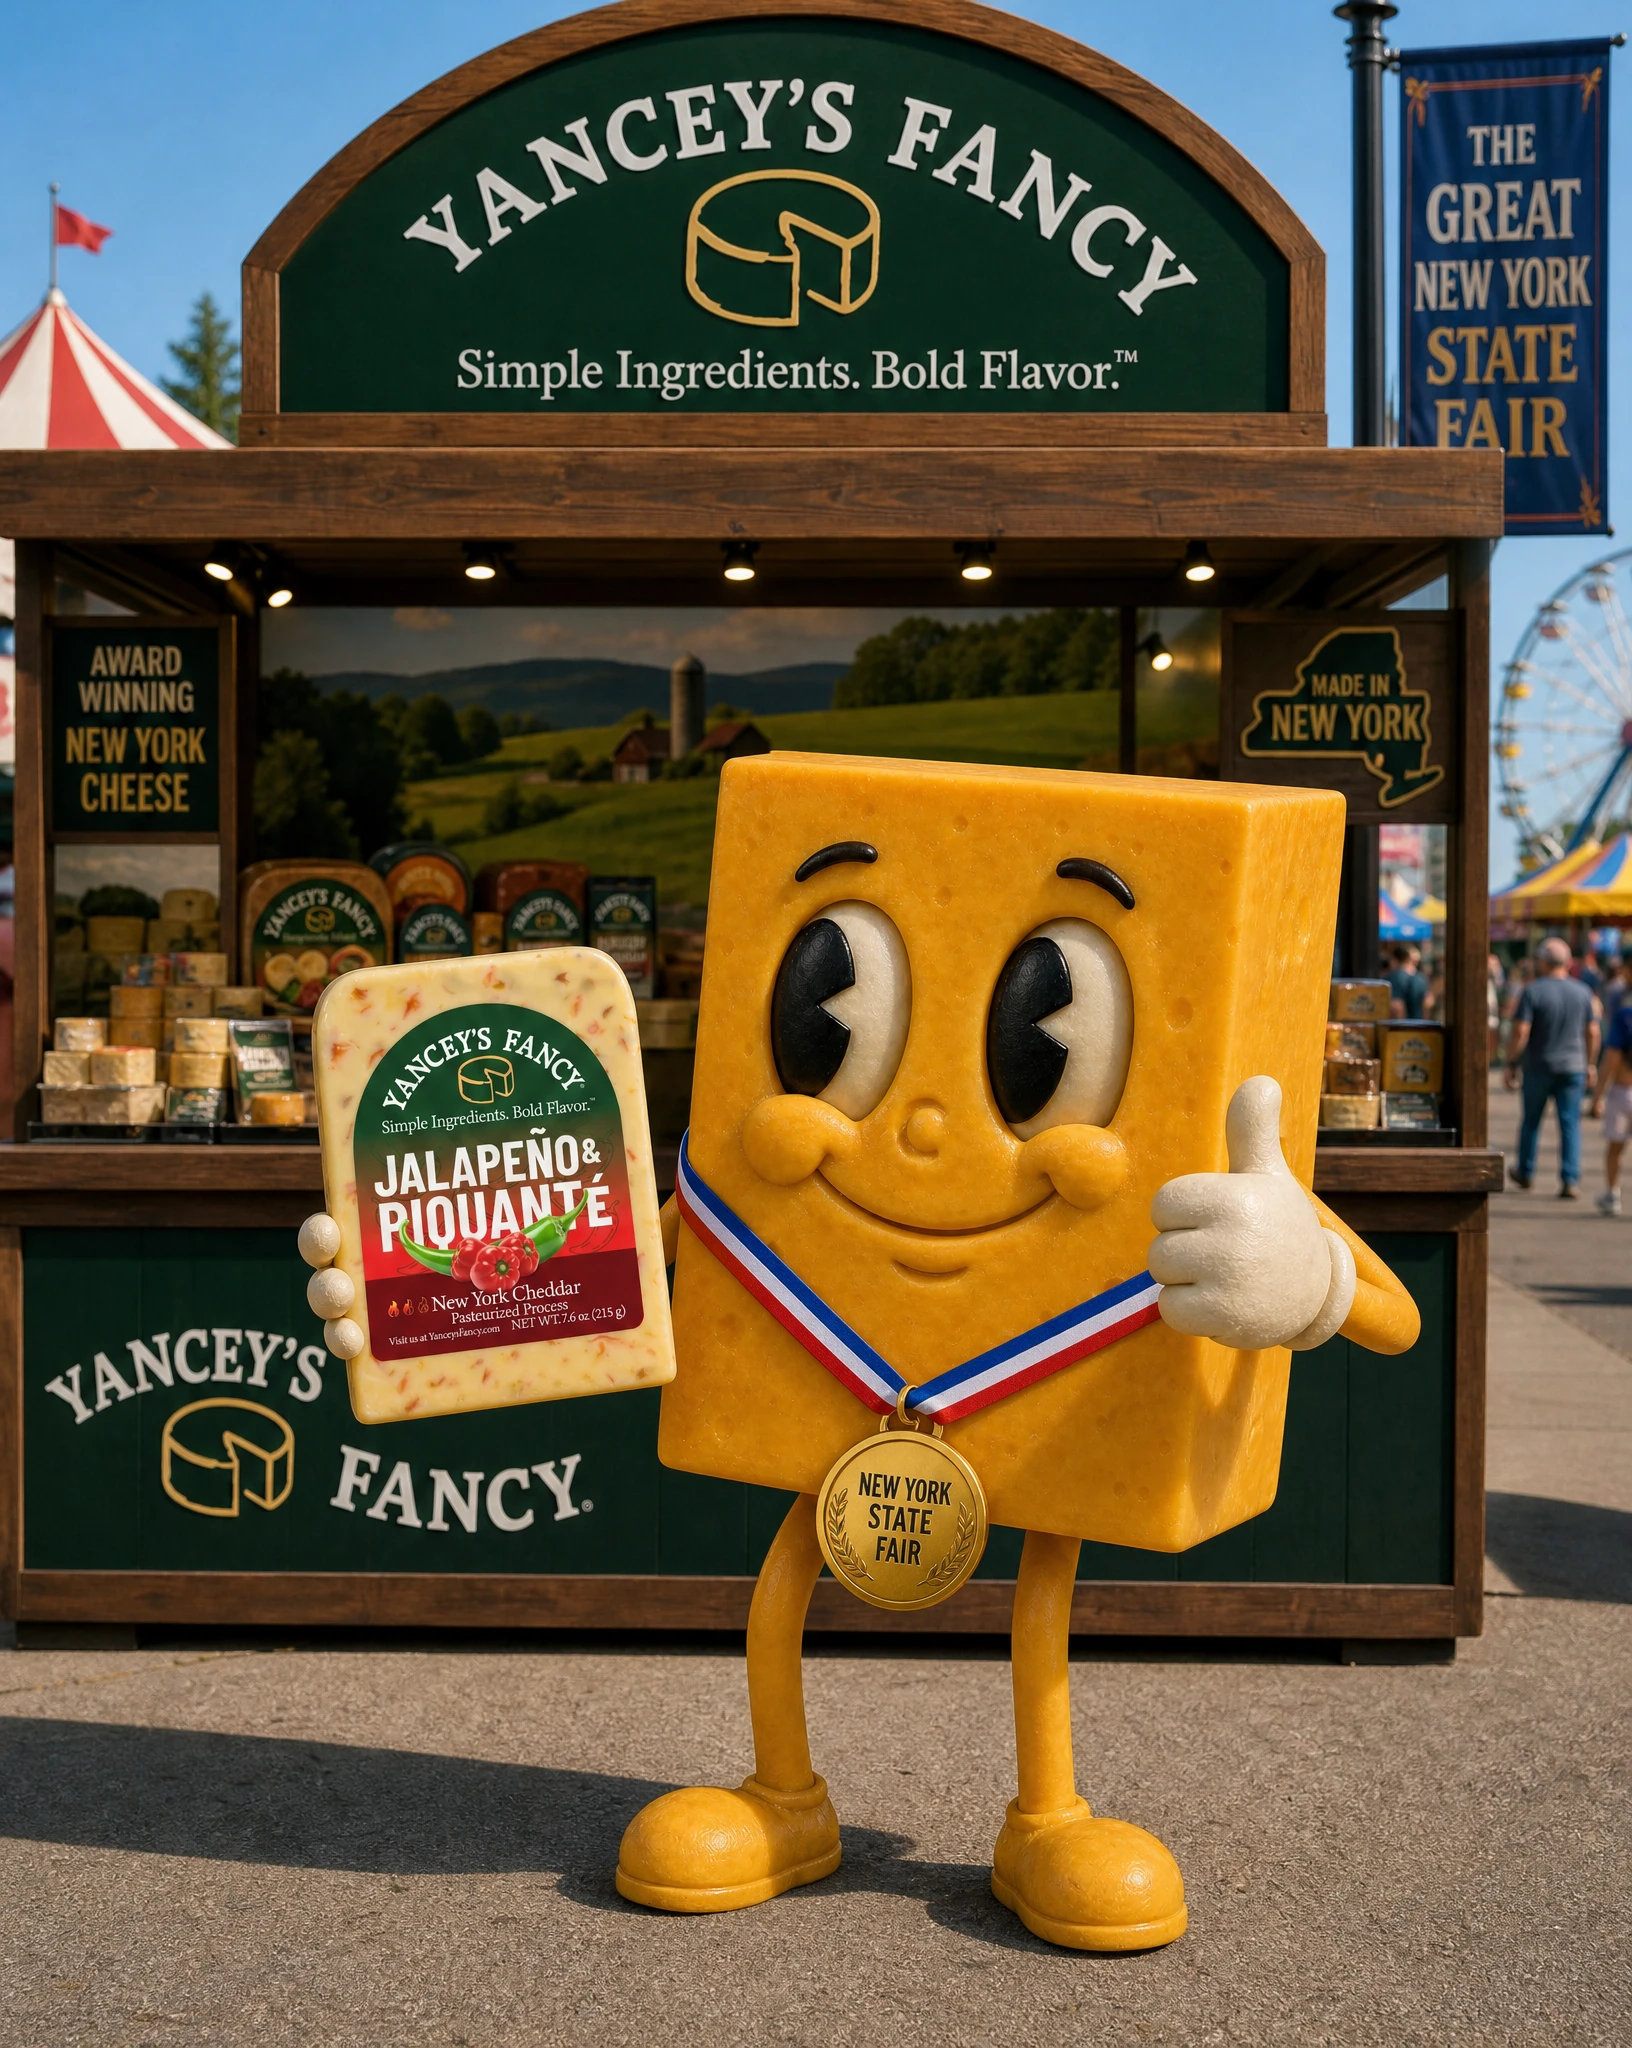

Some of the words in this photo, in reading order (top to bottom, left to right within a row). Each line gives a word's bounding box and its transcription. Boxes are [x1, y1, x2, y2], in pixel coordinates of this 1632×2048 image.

[1467, 123, 1536, 167] THE
[403, 78, 855, 273] YANCEY'S
[887, 96, 1198, 316] FANCY
[1425, 177, 1582, 244] GREAT
[1414, 259, 1494, 312] NEW
[1500, 255, 1593, 309] YORK
[1426, 323, 1579, 386] STATE
[457, 348, 603, 400] Simple
[616, 348, 860, 401] Ingredients.
[872, 348, 967, 390] Bold
[1435, 397, 1571, 459] FAIR
[90, 646, 182, 677] AWARD
[78, 681, 194, 713] WINNING
[1311, 674, 1365, 697] MADE
[1370, 674, 1390, 697] IN
[1271, 704, 1338, 741] NEW
[1345, 704, 1422, 741] YORK
[65, 727, 128, 764] NEW
[134, 727, 207, 764] YORK
[81, 772, 190, 812] CHEESE
[331, 890, 377, 938] FANCY
[382, 1027, 491, 1110] YANCEY'S
[382, 1116, 428, 1135] Simple
[431, 1109, 509, 1131] Ingredients.
[512, 1102, 543, 1119] Bold
[379, 1173, 613, 1253] PIQUANTÉ
[431, 1295, 469, 1312] New
[471, 1288, 510, 1307] York
[512, 1280, 581, 1301] Cheddar
[451, 1304, 519, 1324] Pasteurized
[523, 1301, 568, 1315] Process
[511, 1317, 536, 1330] NET
[578, 1313, 590, 1321] oz
[591, 1307, 614, 1322] (215
[389, 1335, 407, 1346] Visit
[419, 1334, 428, 1342] at
[44, 1328, 327, 1425] YANCEY'S
[858, 1472, 901, 1499] NEW
[904, 1477, 952, 1506] YORK
[868, 1503, 933, 1535] STATE
[875, 1536, 922, 1566] FAIR
